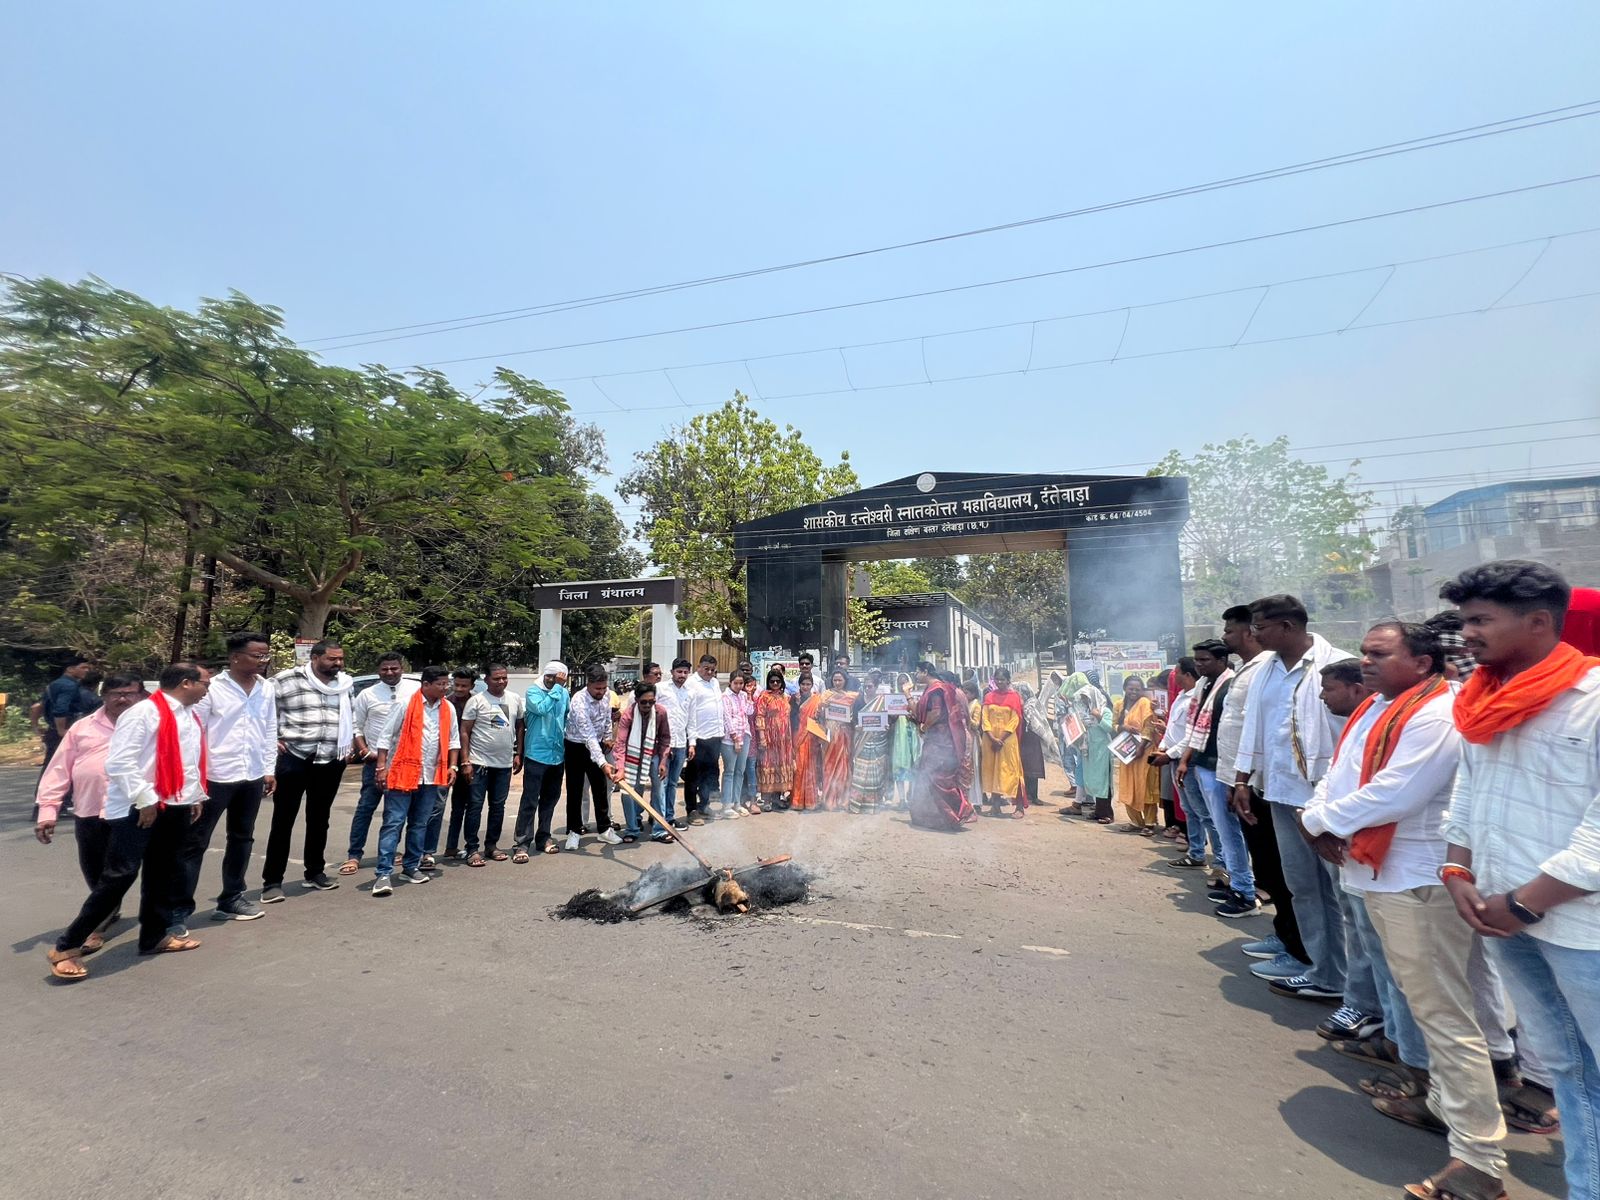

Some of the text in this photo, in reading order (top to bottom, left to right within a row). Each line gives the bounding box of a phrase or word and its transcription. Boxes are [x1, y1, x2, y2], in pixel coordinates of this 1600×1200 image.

[803, 510, 846, 530] शासकीय
[851, 504, 893, 525] दन्तेश्वरी
[896, 499, 957, 521] स्नातकोत्तर
[1040, 485, 1090, 506] दंतेवाड़ा
[886, 527, 901, 538] जिला
[558, 586, 645, 601] जिला ग्रंथालय
[881, 619, 930, 630] ग्रंथालय
